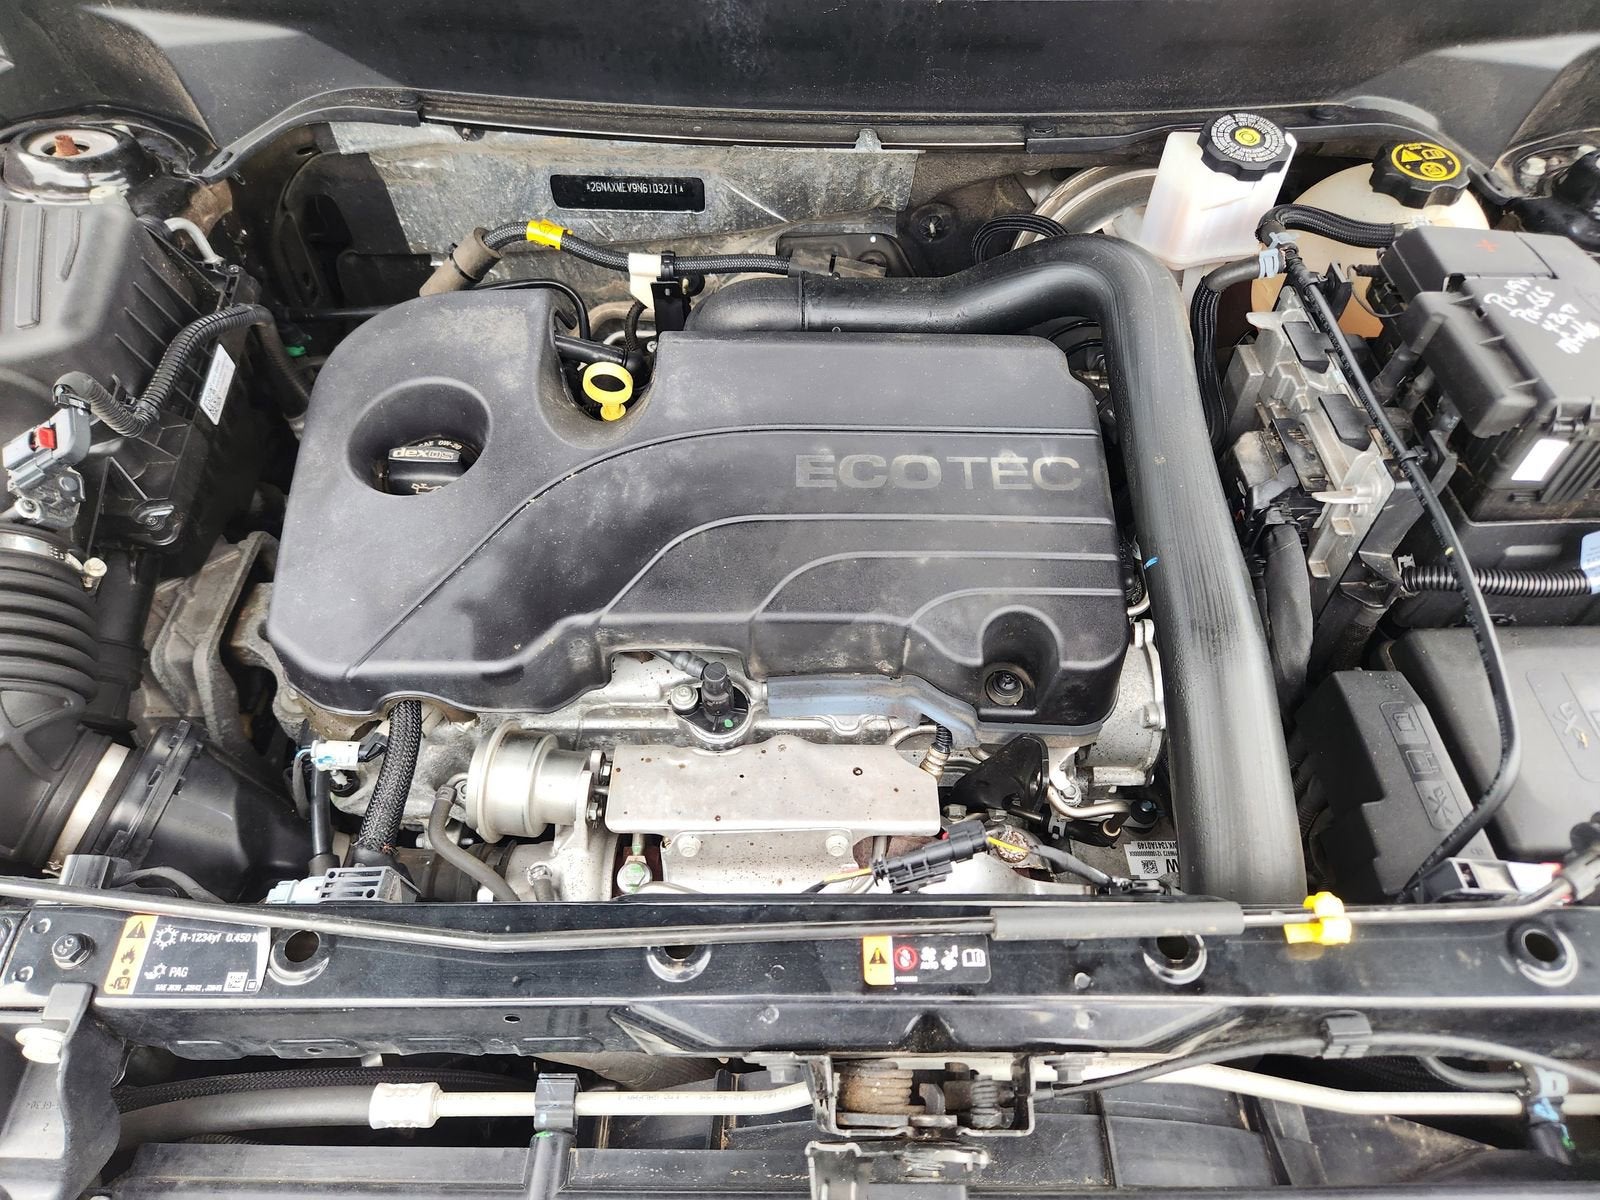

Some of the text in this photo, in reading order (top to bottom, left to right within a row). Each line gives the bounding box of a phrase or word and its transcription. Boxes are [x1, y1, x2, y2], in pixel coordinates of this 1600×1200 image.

[392, 447, 454, 460] dexos
[795, 453, 1082, 491] ECOTEC
[179, 932, 222, 945] R-1234yf
[226, 932, 251, 943] 0.450
[169, 966, 189, 978] PAG
